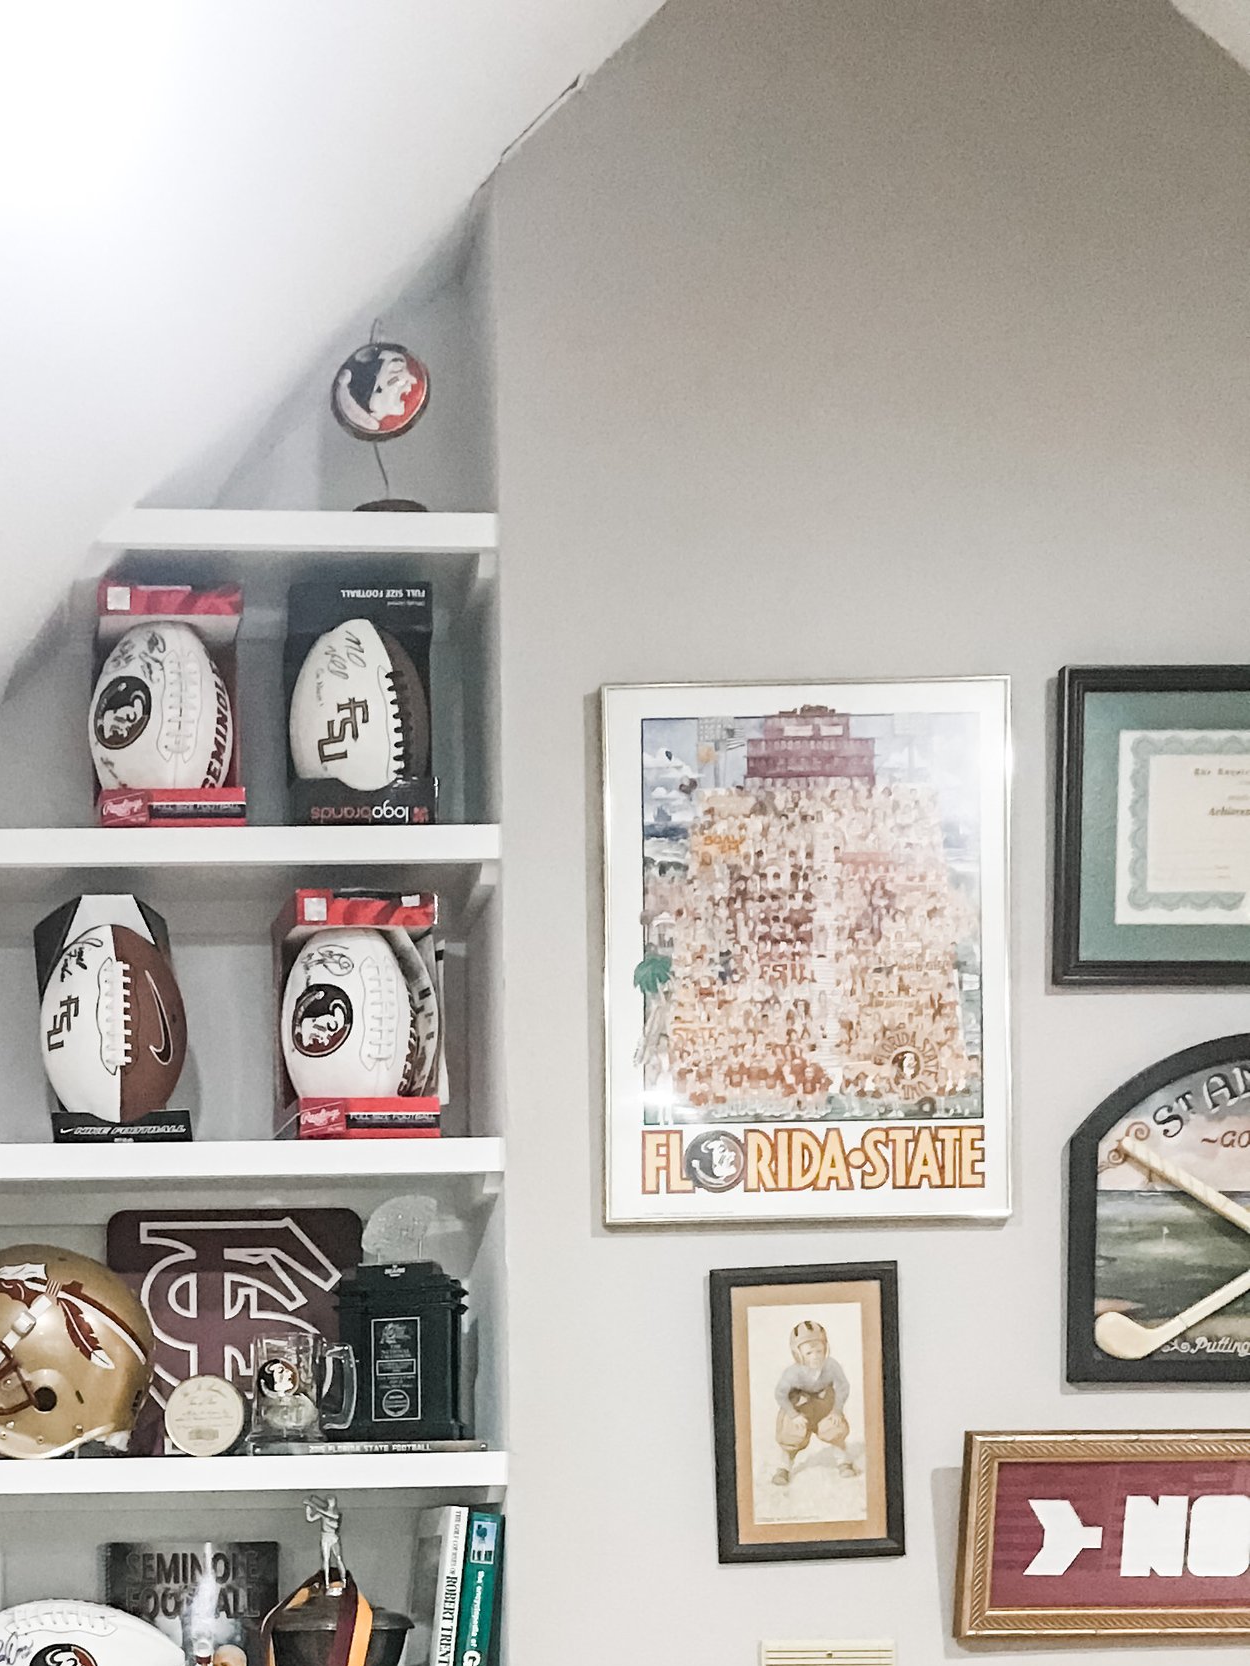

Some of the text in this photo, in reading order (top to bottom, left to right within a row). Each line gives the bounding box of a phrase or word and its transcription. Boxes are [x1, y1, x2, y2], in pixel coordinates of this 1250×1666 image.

[341, 589, 426, 598] FULL SIZE FOOTBALL
[311, 800, 409, 824] logobrands
[363, 1444, 390, 1452] STATE
[392, 1443, 432, 1452] FOOTBALL
[442, 1575, 460, 1623] ROBERT
[437, 1626, 454, 1666] TRENT
